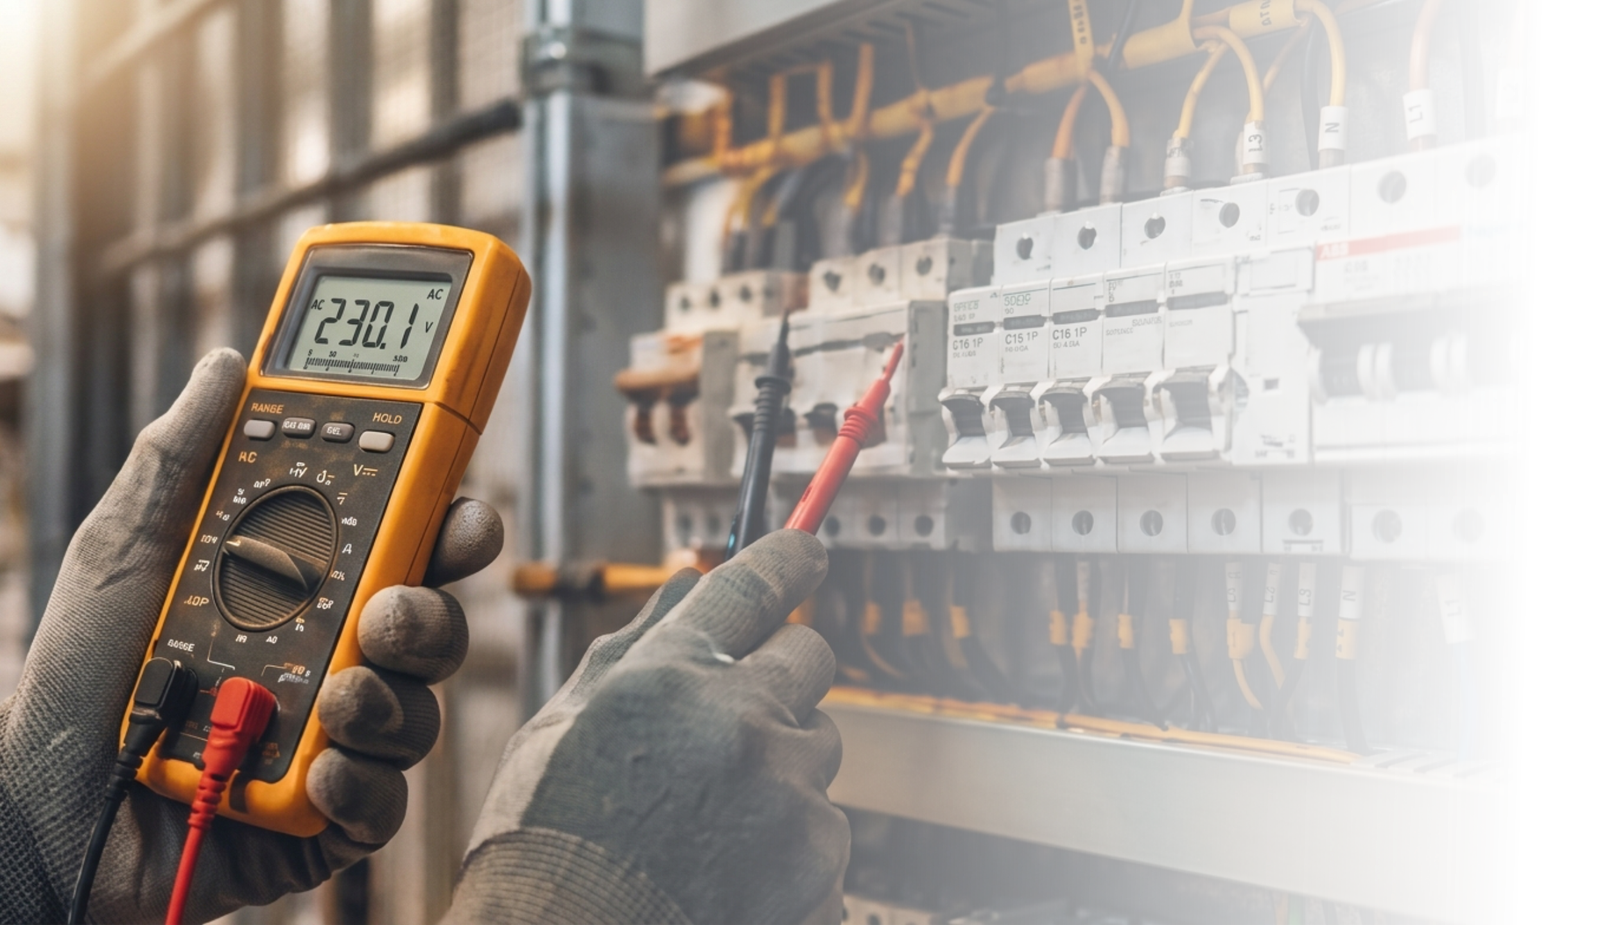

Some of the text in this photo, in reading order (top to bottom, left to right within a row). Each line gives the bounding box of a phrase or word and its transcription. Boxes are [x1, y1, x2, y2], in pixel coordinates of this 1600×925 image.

[1409, 103, 1424, 123] L1
[1325, 122, 1340, 133] N
[1248, 133, 1263, 153] L3
[427, 288, 443, 300] AC
[311, 298, 434, 350] AC 230.1 V
[1027, 331, 1039, 341] 1P
[1074, 327, 1087, 338] 1P
[973, 337, 984, 348] 1P
[372, 412, 402, 425] HOLD
[1342, 589, 1356, 602] N
[1444, 598, 1462, 617] L1
